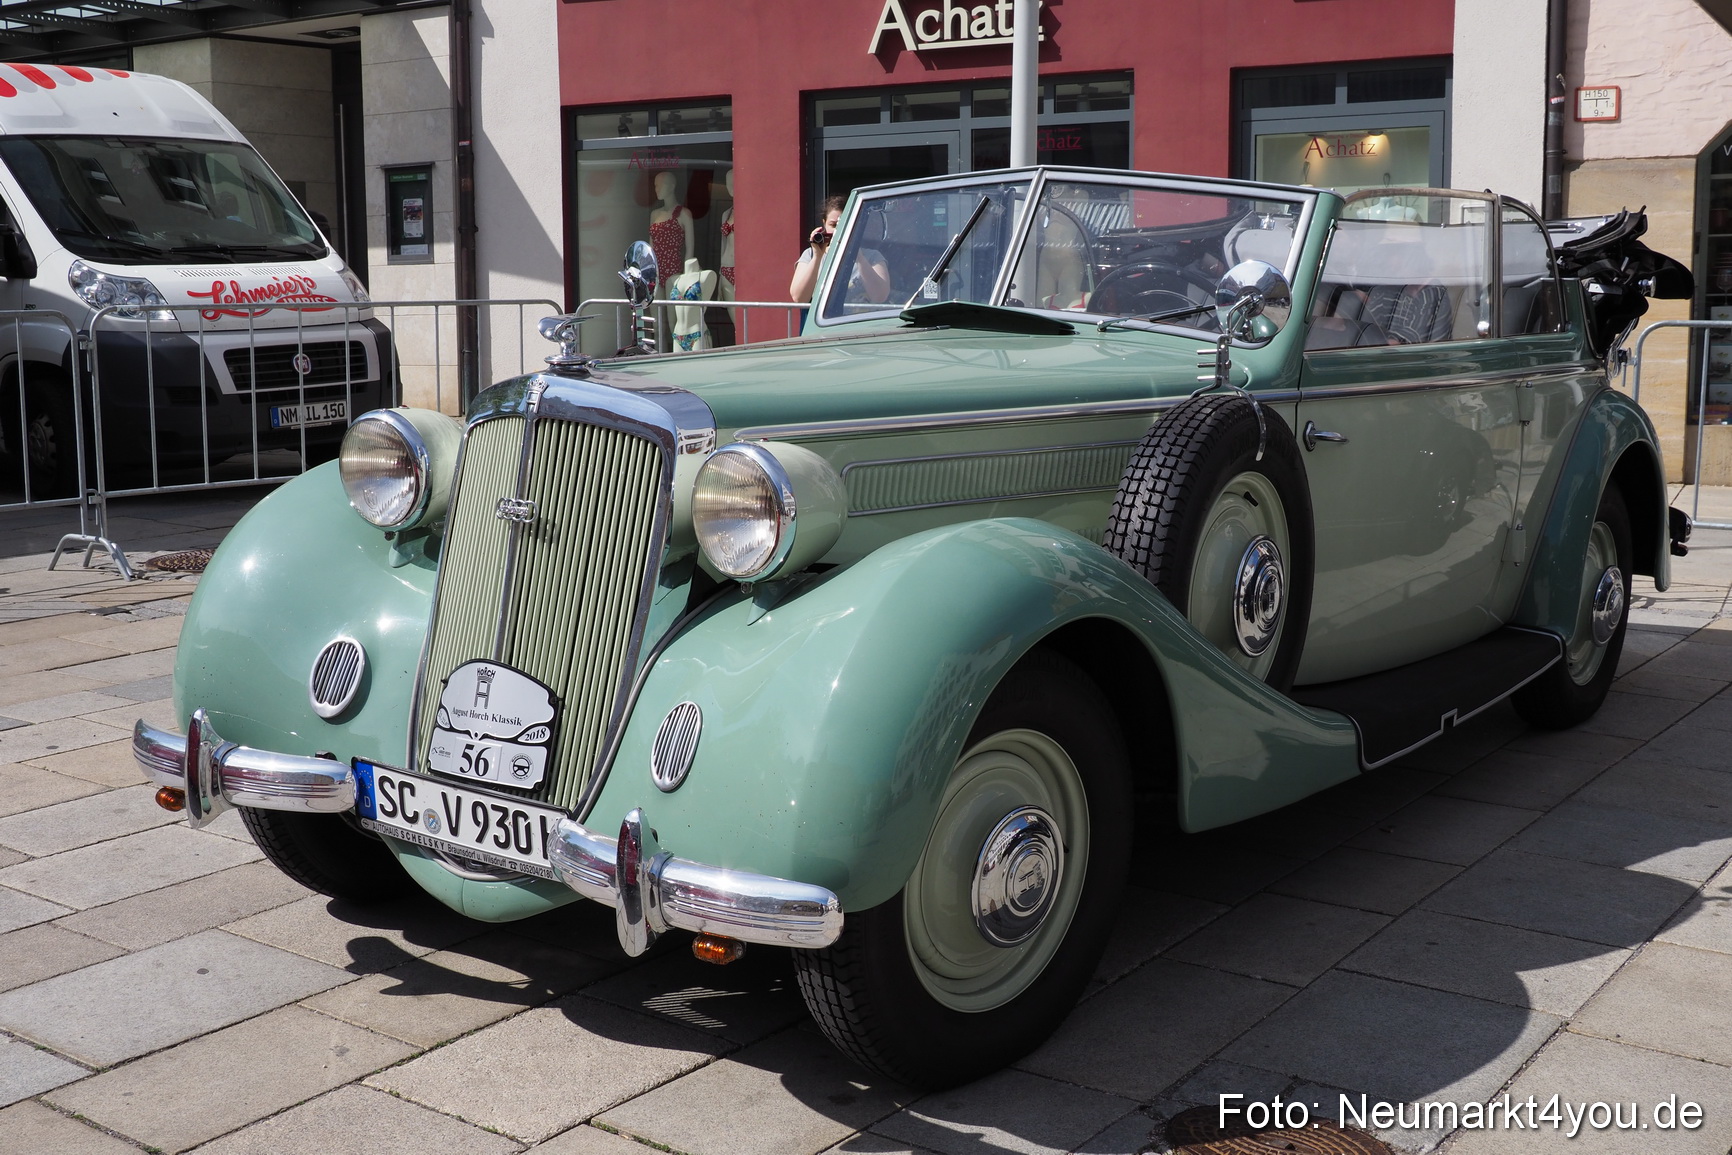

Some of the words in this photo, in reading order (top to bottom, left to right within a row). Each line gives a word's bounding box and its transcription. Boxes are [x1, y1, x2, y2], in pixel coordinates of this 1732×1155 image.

[868, 0, 1045, 54] Achat
[1305, 136, 1377, 159] Achatz
[627, 151, 680, 170] Achatz
[280, 407, 298, 424] NM
[305, 406, 321, 421] IL
[322, 403, 345, 420] 150
[452, 706, 469, 717] August
[470, 709, 489, 721] Horch
[491, 713, 522, 726] Klassik
[524, 727, 547, 741] 2018
[459, 743, 492, 777] 56
[378, 775, 419, 825] SC
[441, 791, 462, 837] V
[372, 822, 400, 838] AUTOHAUS
[400, 830, 446, 850] SCHELSKY
[447, 843, 476, 858] Braunsdorf
[483, 854, 507, 868] Wilsdruff
